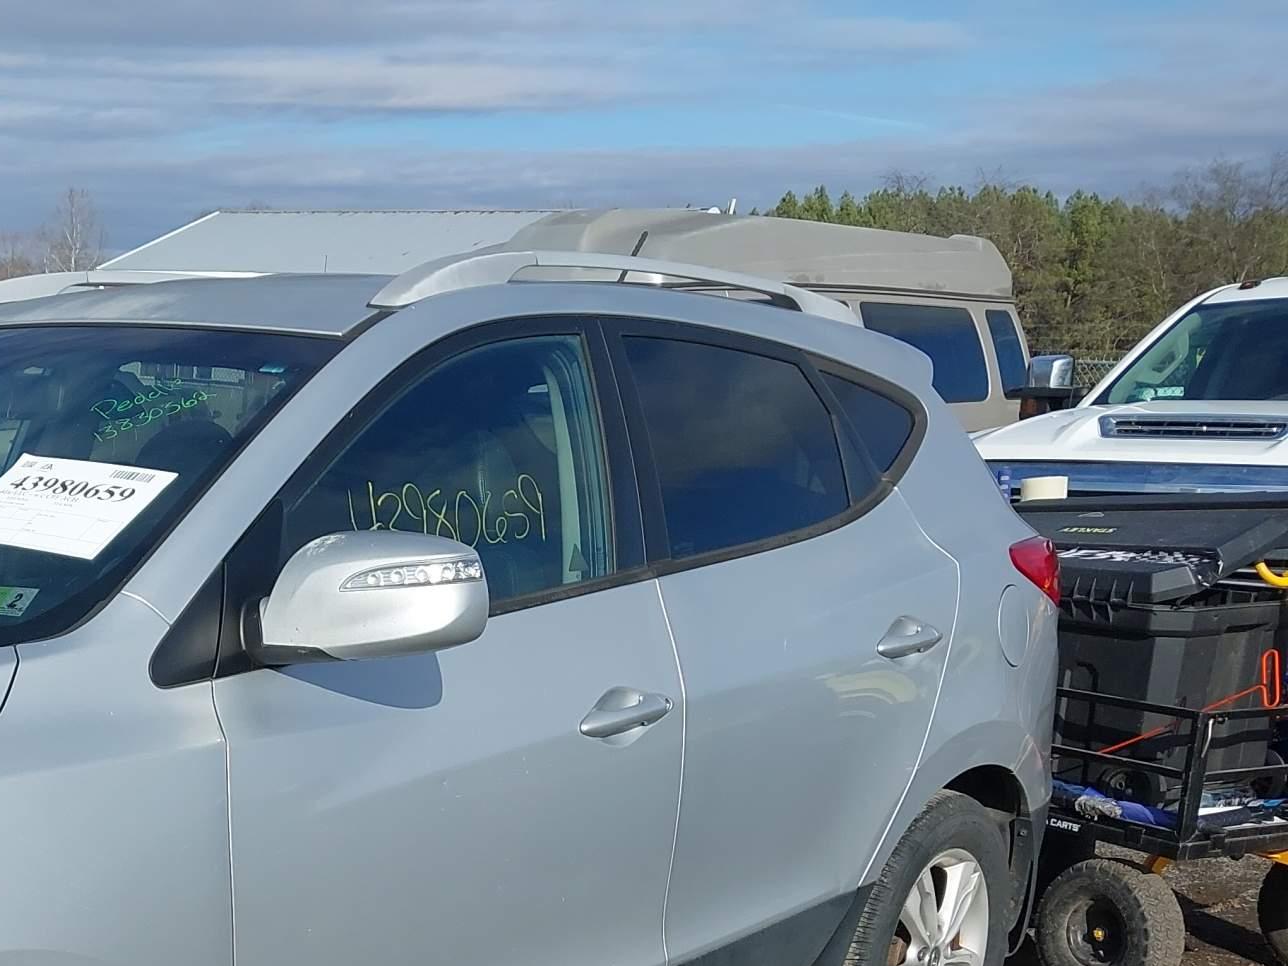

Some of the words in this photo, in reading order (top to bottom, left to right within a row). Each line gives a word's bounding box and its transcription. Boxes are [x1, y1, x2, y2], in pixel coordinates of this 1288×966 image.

[10, 475, 136, 502] 43980659
[7, 592, 24, 609] 2
[1050, 818, 1079, 832] CARTS
